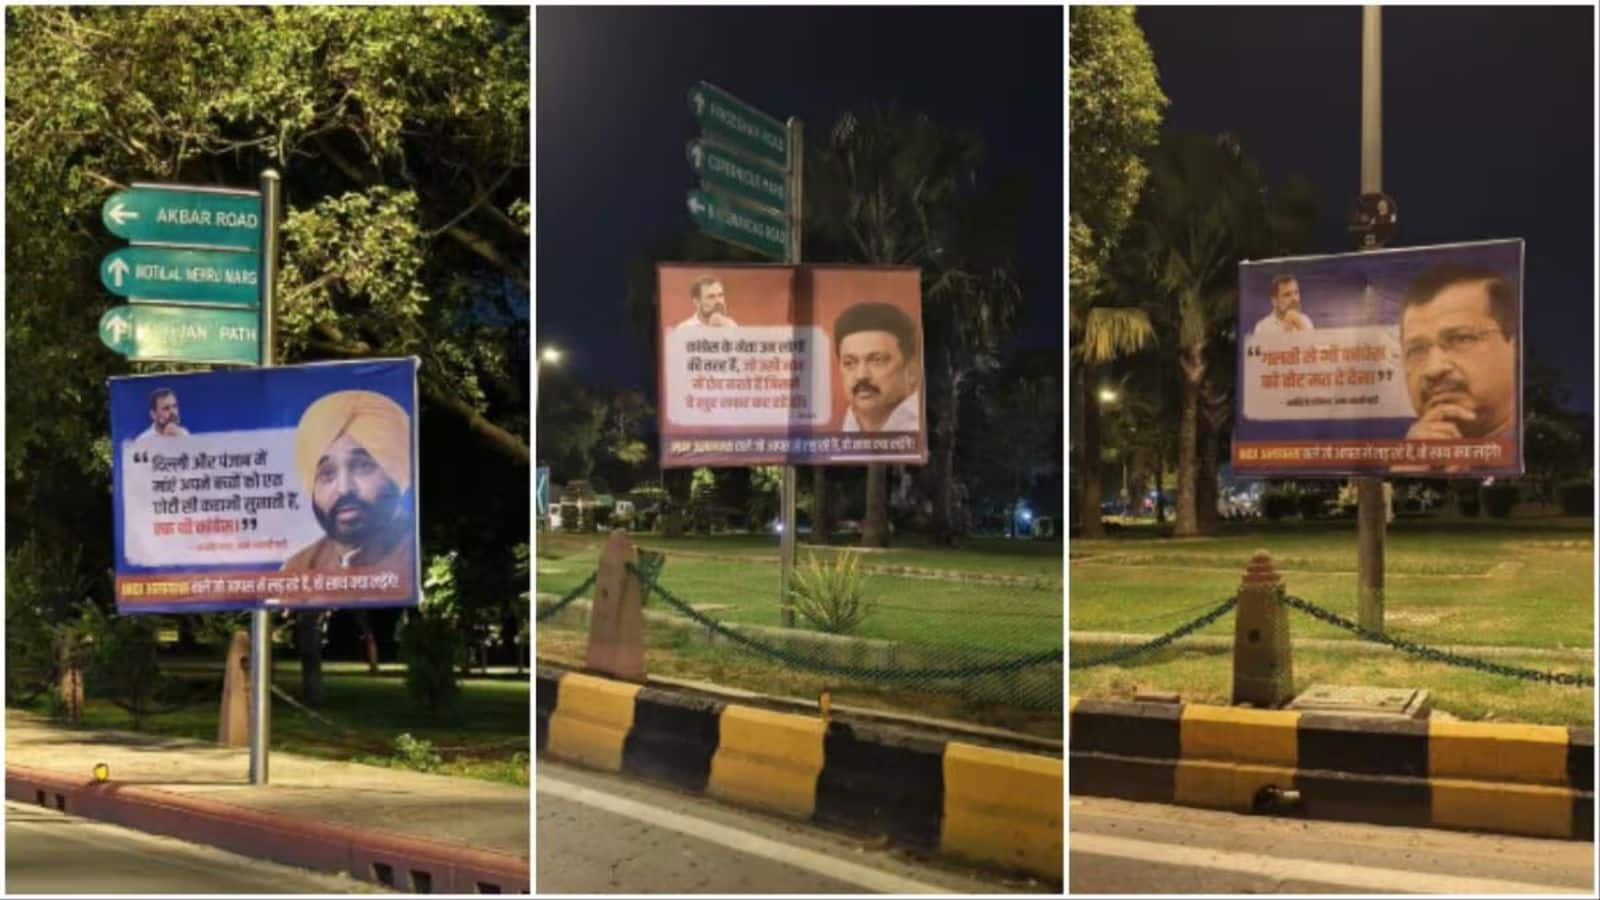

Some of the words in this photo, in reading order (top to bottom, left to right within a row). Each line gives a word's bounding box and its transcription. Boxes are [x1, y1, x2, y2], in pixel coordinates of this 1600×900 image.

[157, 208, 211, 225] AKBAR
[215, 211, 258, 229] ROAD
[186, 267, 221, 284] NEHRU
[219, 325, 257, 343] PATH
